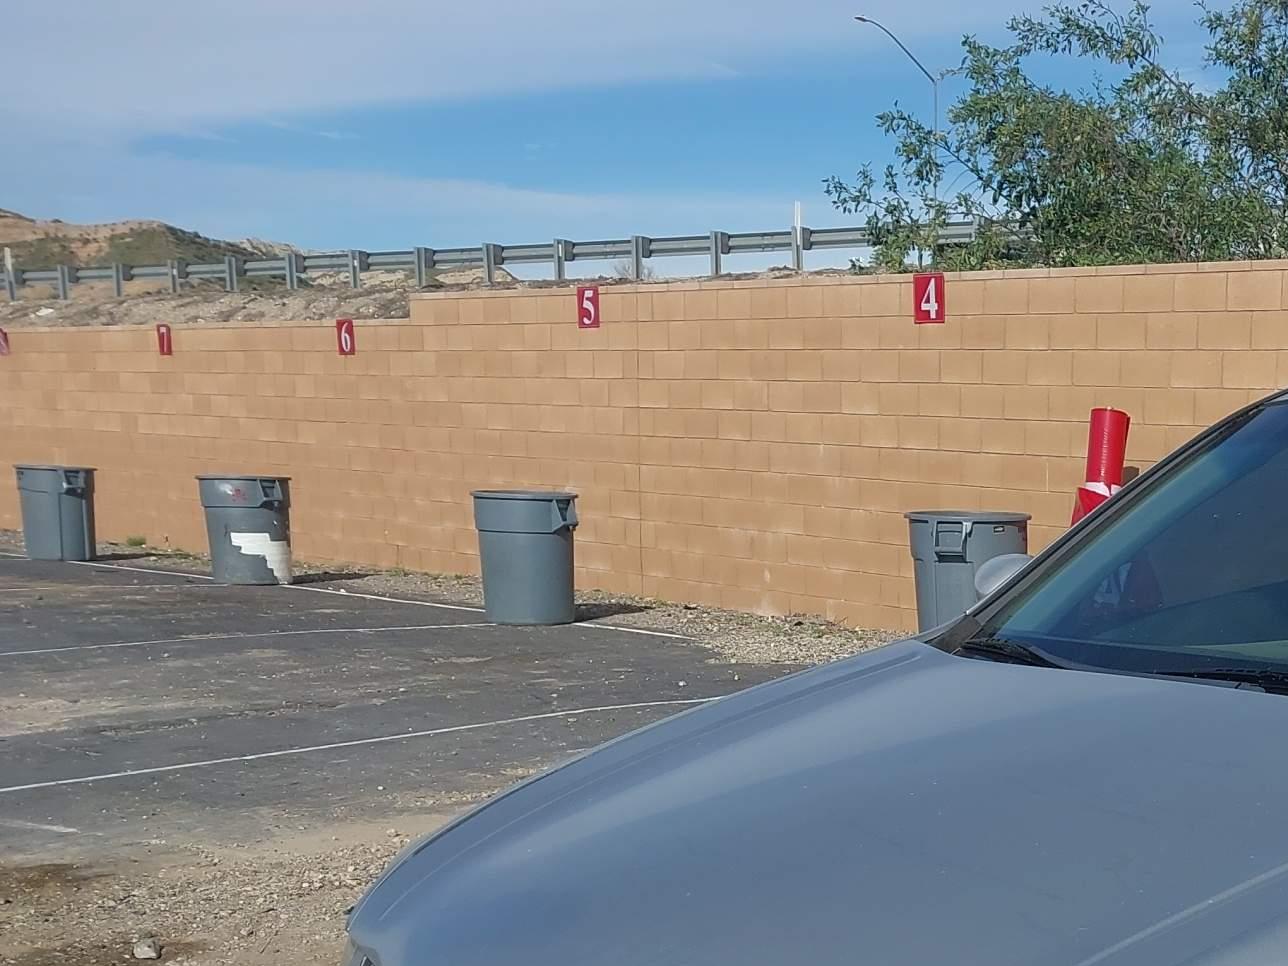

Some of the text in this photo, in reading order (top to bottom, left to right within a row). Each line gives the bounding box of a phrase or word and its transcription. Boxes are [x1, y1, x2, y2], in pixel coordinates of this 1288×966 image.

[582, 289, 595, 325] 5
[920, 277, 939, 320] 4
[340, 321, 351, 352] 6
